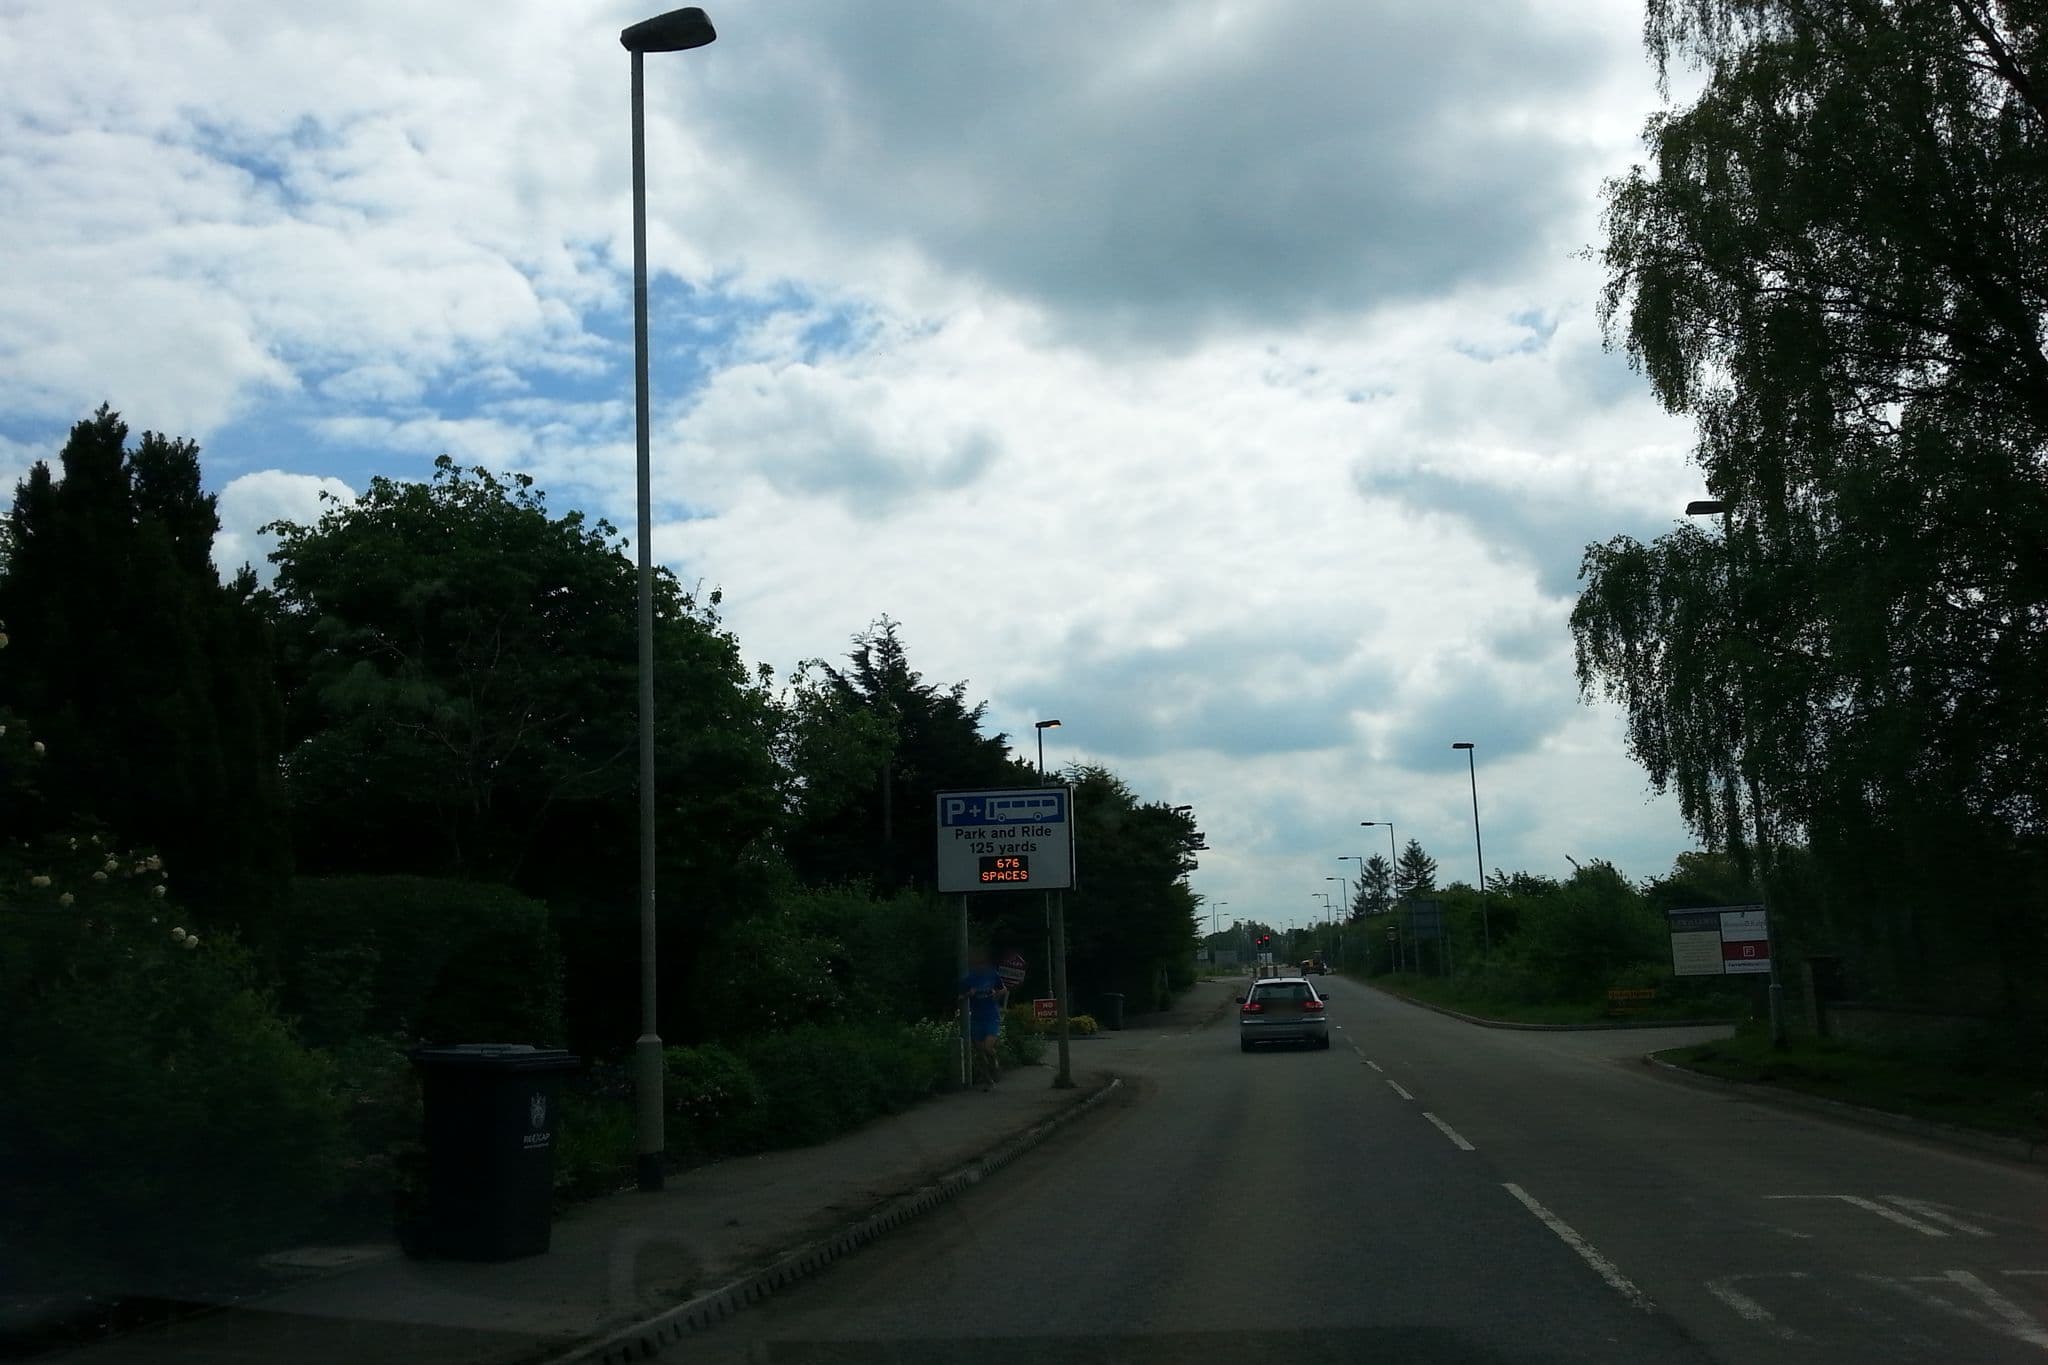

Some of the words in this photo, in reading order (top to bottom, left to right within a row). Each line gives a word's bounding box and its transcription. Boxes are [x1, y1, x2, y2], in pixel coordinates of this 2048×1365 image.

[955, 828, 986, 840] Park
[991, 826, 1015, 839] and
[1022, 825, 1052, 838] Ride
[970, 842, 994, 854] 125
[999, 841, 1037, 855] yards
[996, 858, 1020, 869] 676
[981, 870, 1028, 882] SPACES
